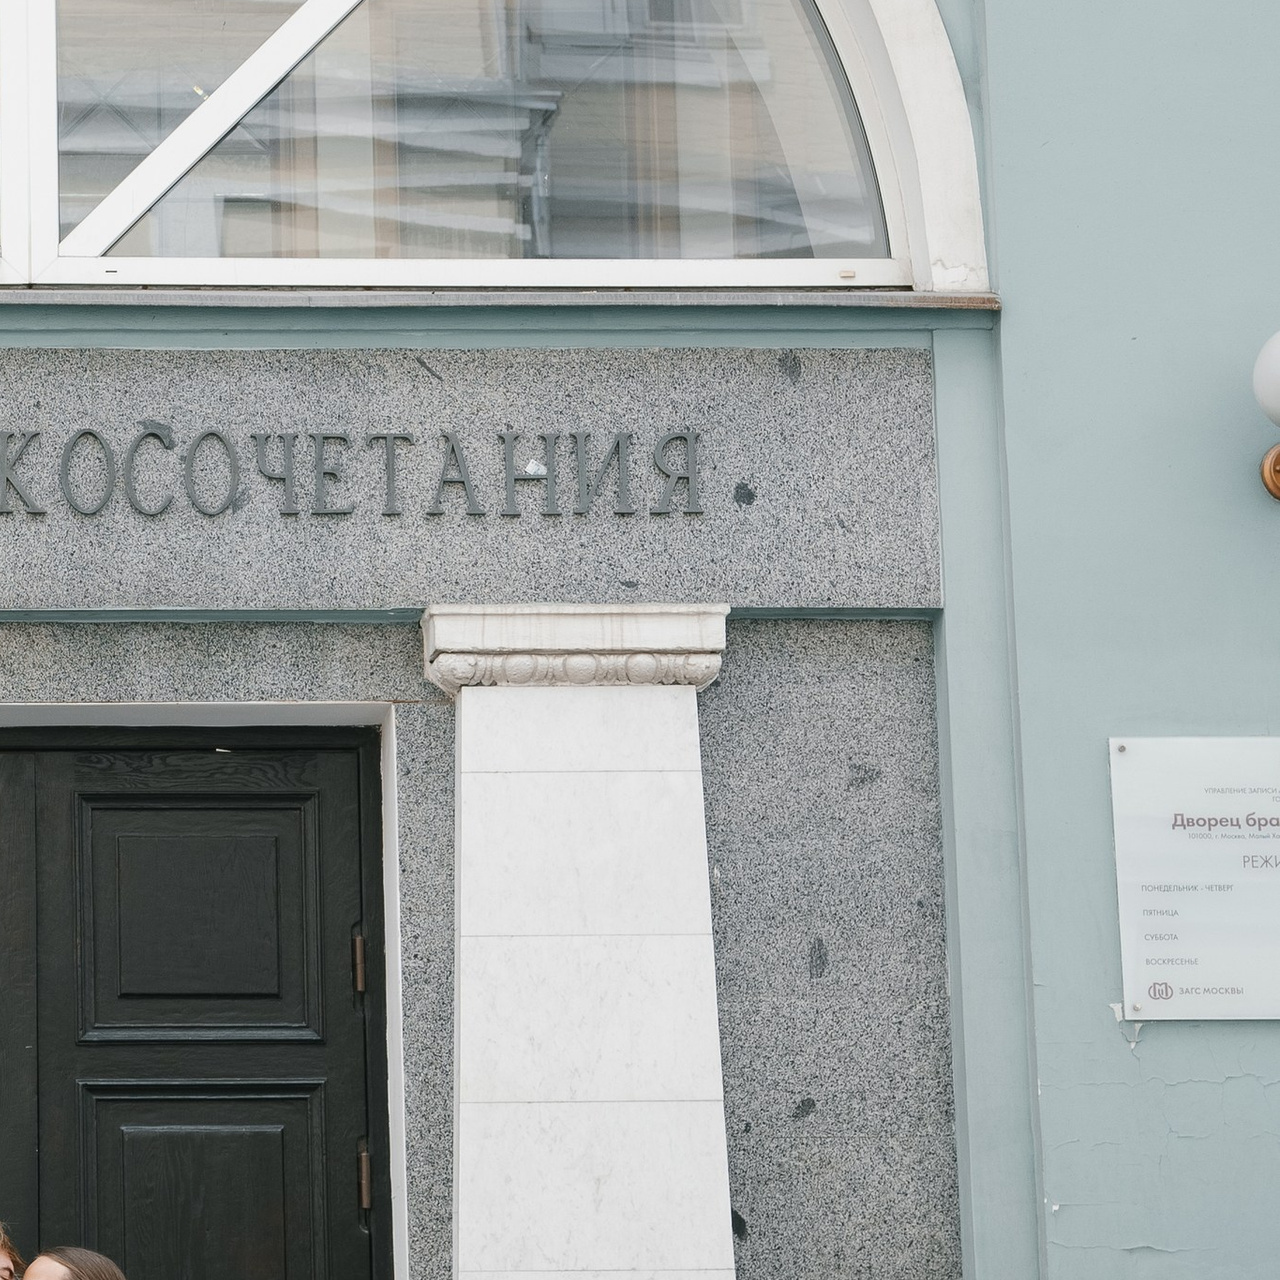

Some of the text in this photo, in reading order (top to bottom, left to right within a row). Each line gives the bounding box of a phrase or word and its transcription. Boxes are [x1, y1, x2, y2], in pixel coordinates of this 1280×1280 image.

[1171, 811, 1280, 831] Дворец бра
[1141, 884, 1199, 893] ПОНЕДЕЛЬНИК
[1205, 884, 1234, 892] ЧЕТВЕРГ
[1142, 909, 1179, 918] ПЯТНИЦА
[1144, 933, 1179, 941] СУББОТА
[1145, 958, 1199, 966] ВОСКРЕСЕНЬЕ
[1179, 987, 1244, 995] ЗАГС МОСКВЫ
